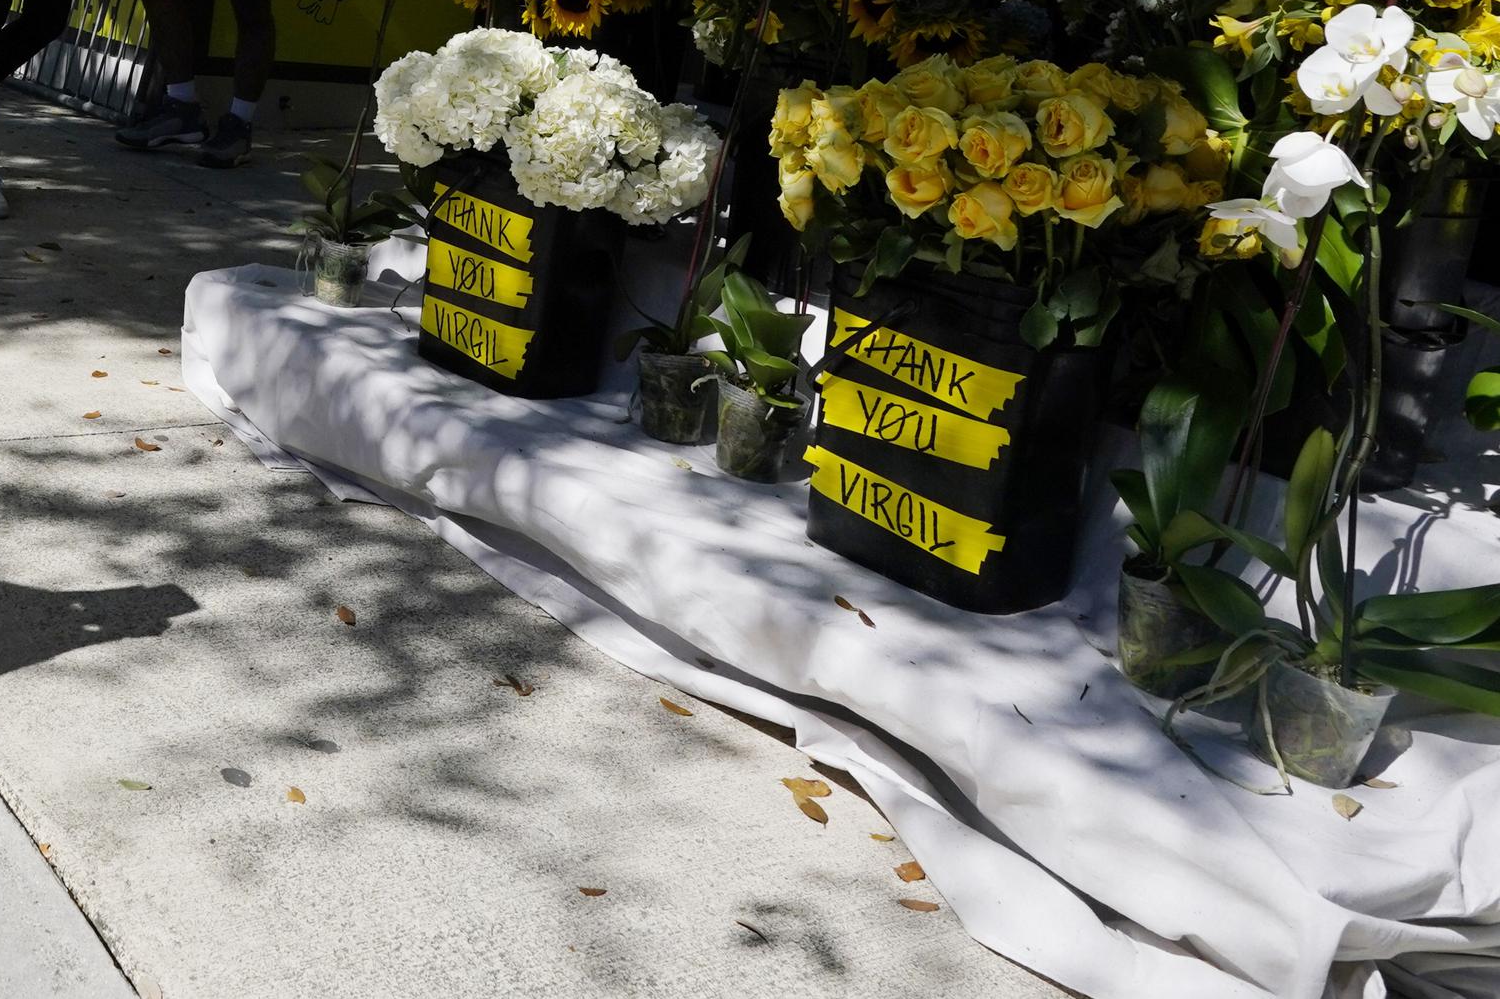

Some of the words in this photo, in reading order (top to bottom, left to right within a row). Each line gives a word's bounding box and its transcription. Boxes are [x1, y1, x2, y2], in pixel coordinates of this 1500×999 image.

[446, 196, 515, 251] THANK
[434, 303, 509, 367] VIRGIL
[840, 463, 956, 552] VIRGIL
